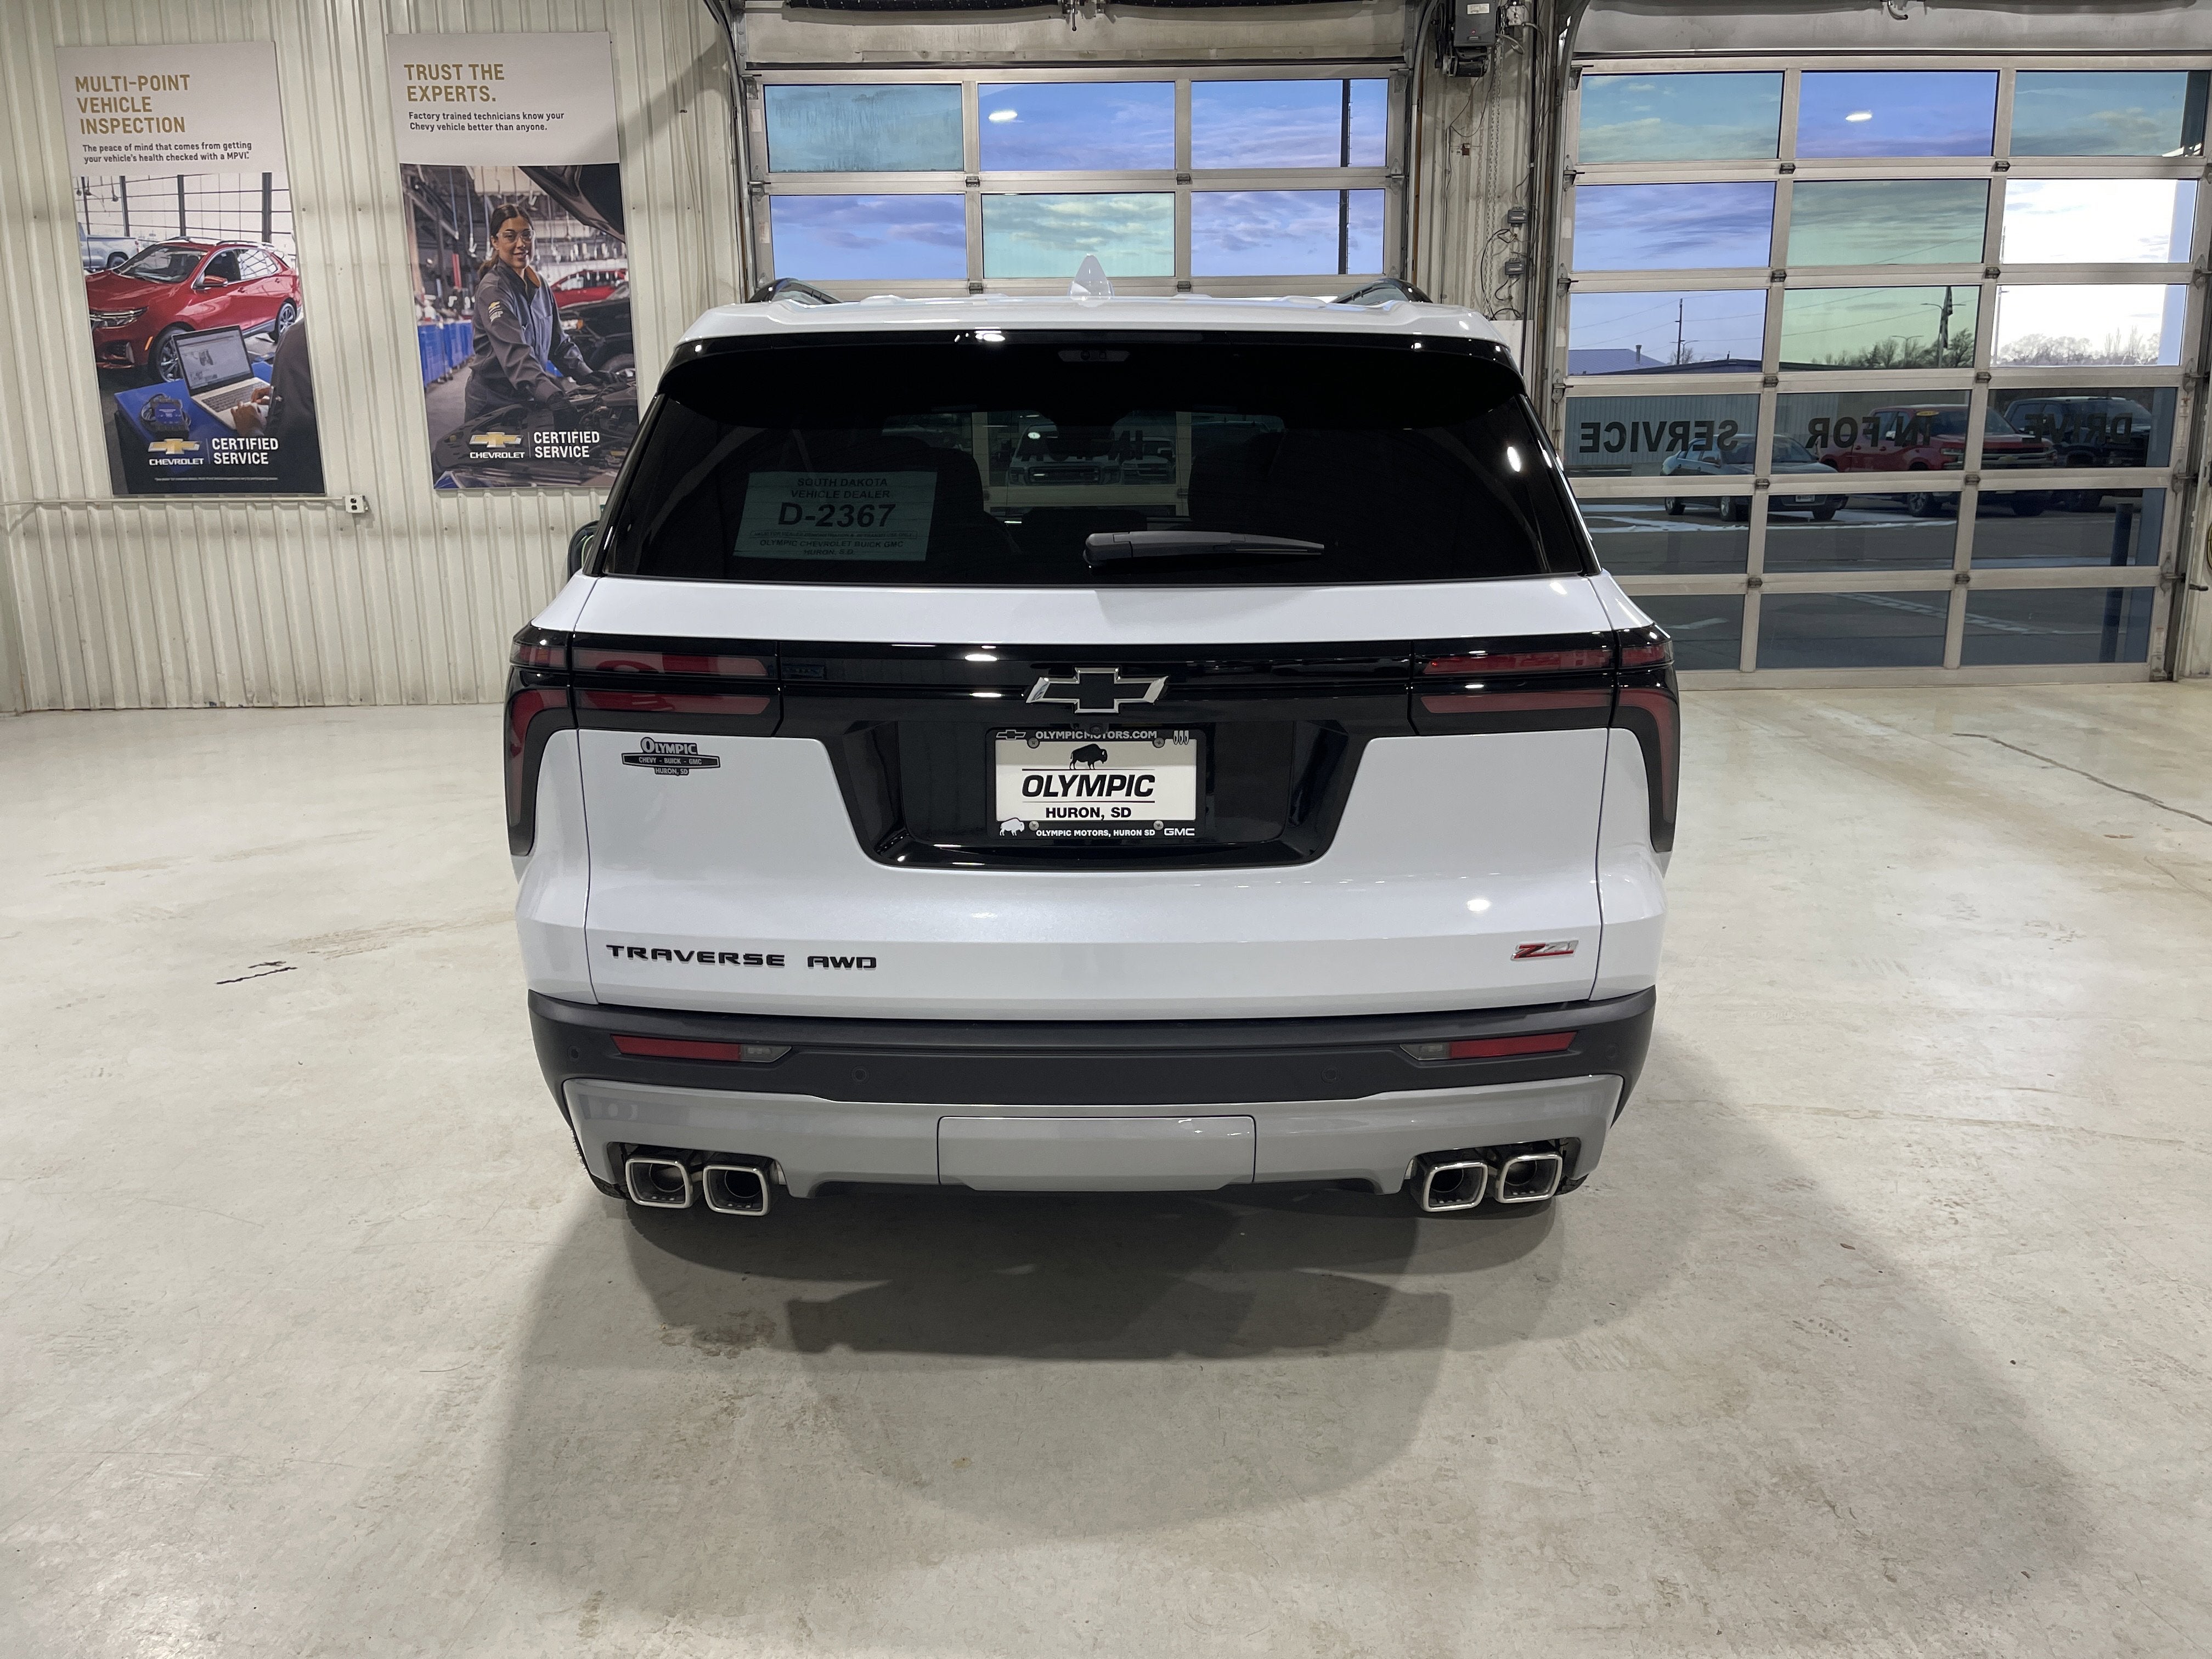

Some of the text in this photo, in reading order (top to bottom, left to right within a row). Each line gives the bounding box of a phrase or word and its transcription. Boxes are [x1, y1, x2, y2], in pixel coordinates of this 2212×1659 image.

[404, 64, 505, 80] TRUST THE
[75, 74, 190, 93] MULTI-POINT
[407, 86, 496, 102] EXPERTS.
[77, 97, 153, 113] VEHICLE
[409, 111, 440, 122] Factory
[442, 112, 471, 120] trained
[473, 112, 521, 120] technicians
[546, 112, 565, 121] your
[80, 117, 186, 134] INSPECTION
[410, 122, 435, 132] Chevy
[516, 124, 548, 132] anyone.
[99, 145, 122, 154] peace
[125, 144, 132, 152] of
[134, 143, 154, 151] mind
[201, 142, 221, 150] from
[223, 142, 252, 151] getting
[84, 155, 101, 165] your
[104, 154, 137, 162] vehicle's
[166, 153, 198, 161] checked
[211, 437, 279, 450] CERTIFIED
[533, 431, 600, 444] CERTIFIED
[534, 445, 590, 458] SERVICE
[149, 458, 205, 466] CHEVROLET
[213, 452, 269, 465] SERVICE
[797, 478, 888, 487] SOUTH DAKOTA
[791, 490, 890, 499] VEHICLE DEALER
[778, 501, 896, 527] D-2367
[1022, 774, 1155, 797] OLYMPIC
[1046, 807, 1132, 821] HURON, SD
[1074, 830, 1111, 838] MOTORS,
[1164, 828, 1195, 836] GMC
[606, 944, 877, 969] TRAVERSE AWD
